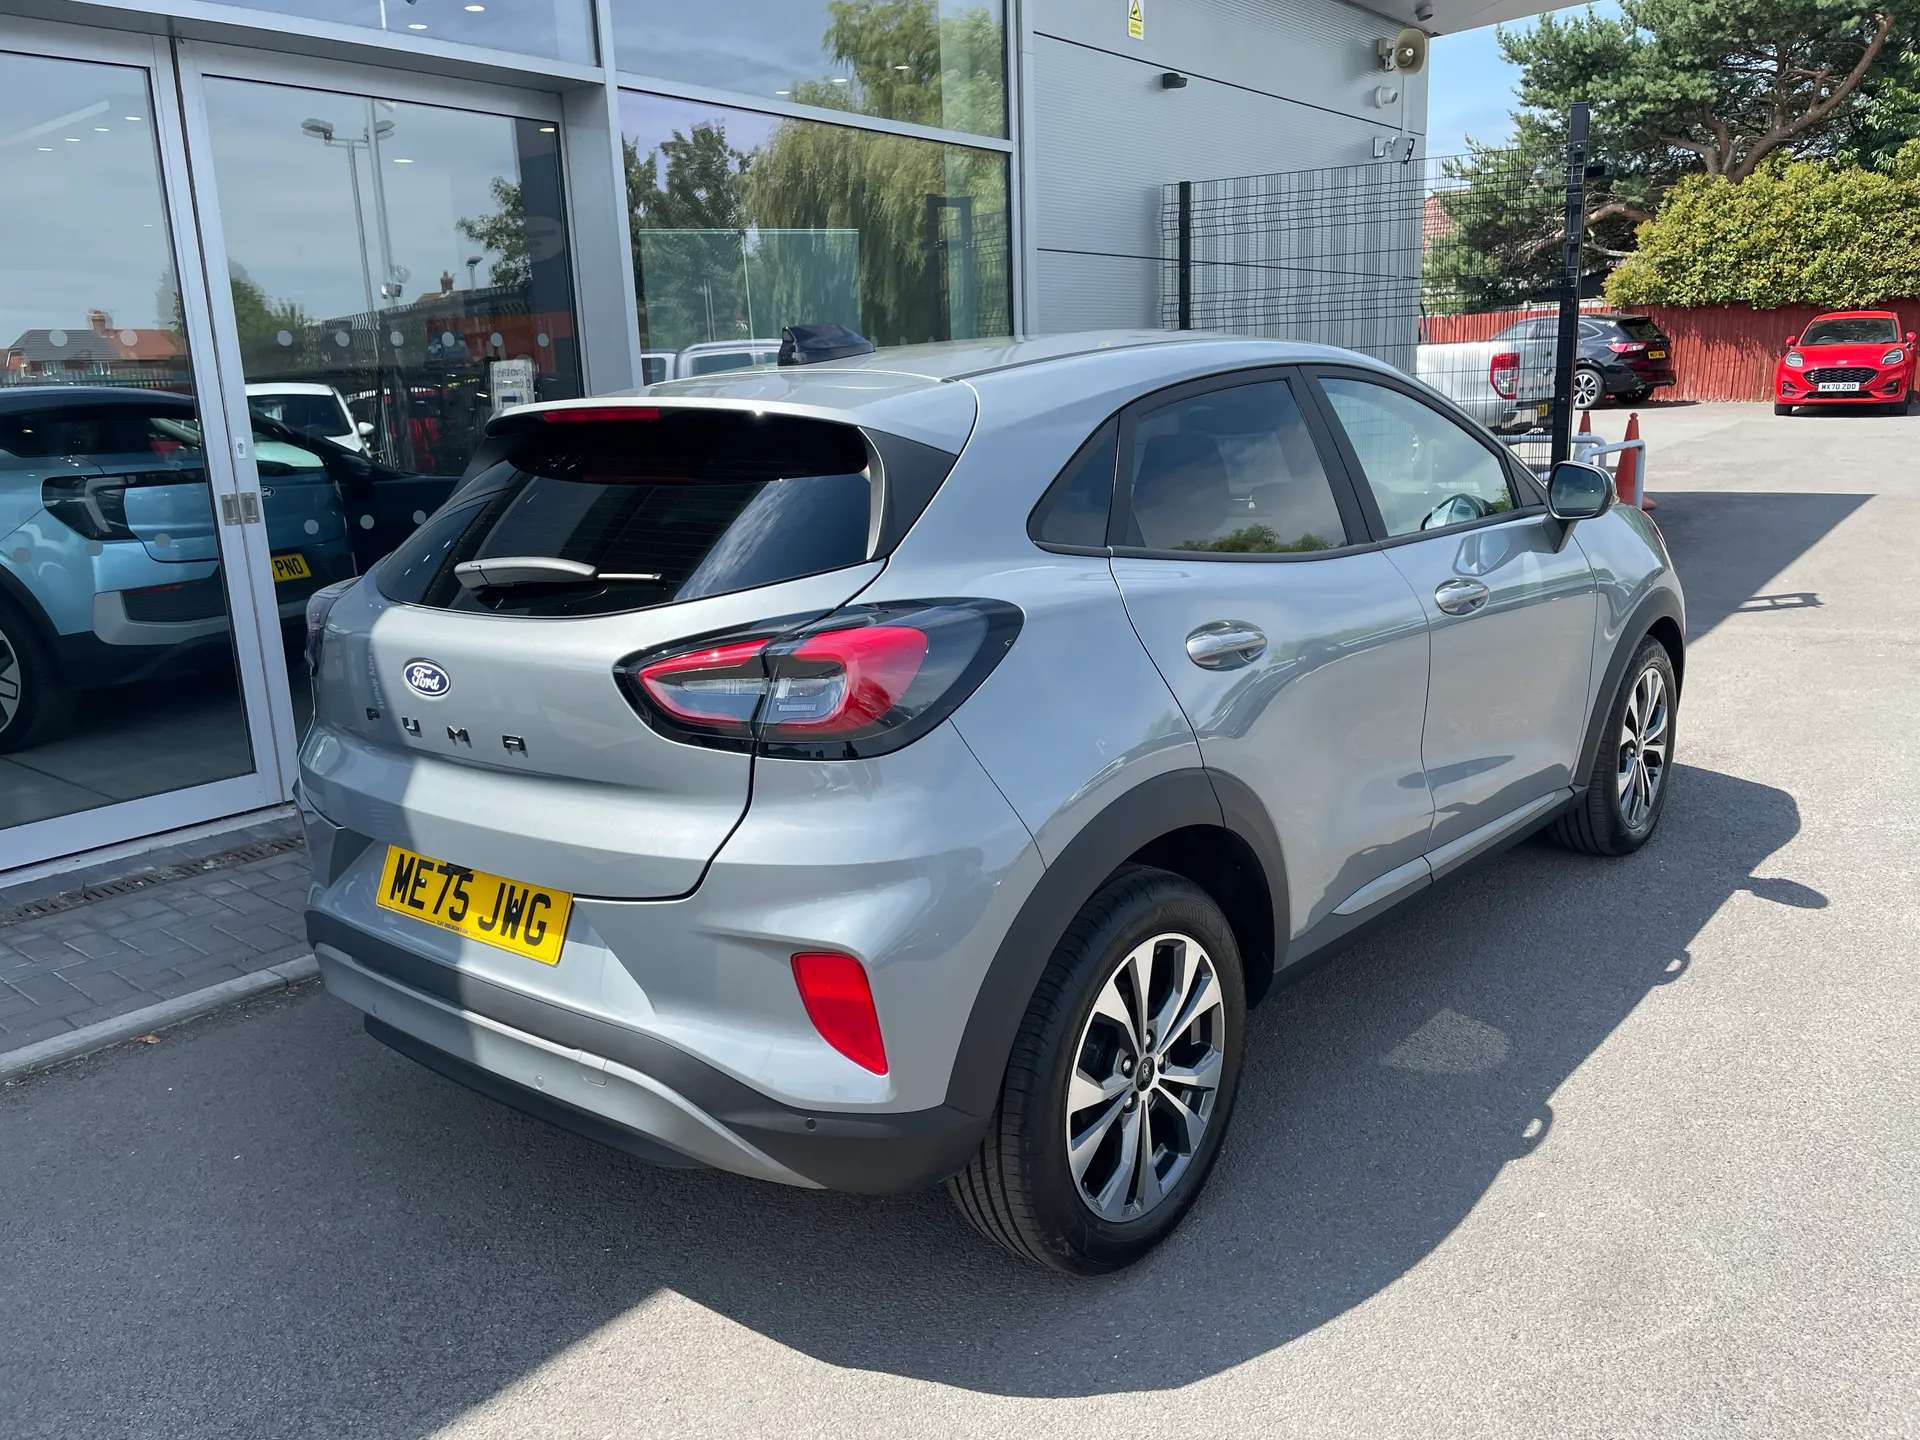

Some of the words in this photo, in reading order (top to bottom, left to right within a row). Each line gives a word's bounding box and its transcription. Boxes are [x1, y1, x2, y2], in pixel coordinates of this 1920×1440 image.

[411, 665, 441, 691] Ford
[366, 706, 528, 754] PUMA
[389, 853, 475, 922] ME75
[477, 882, 552, 947] JWG
